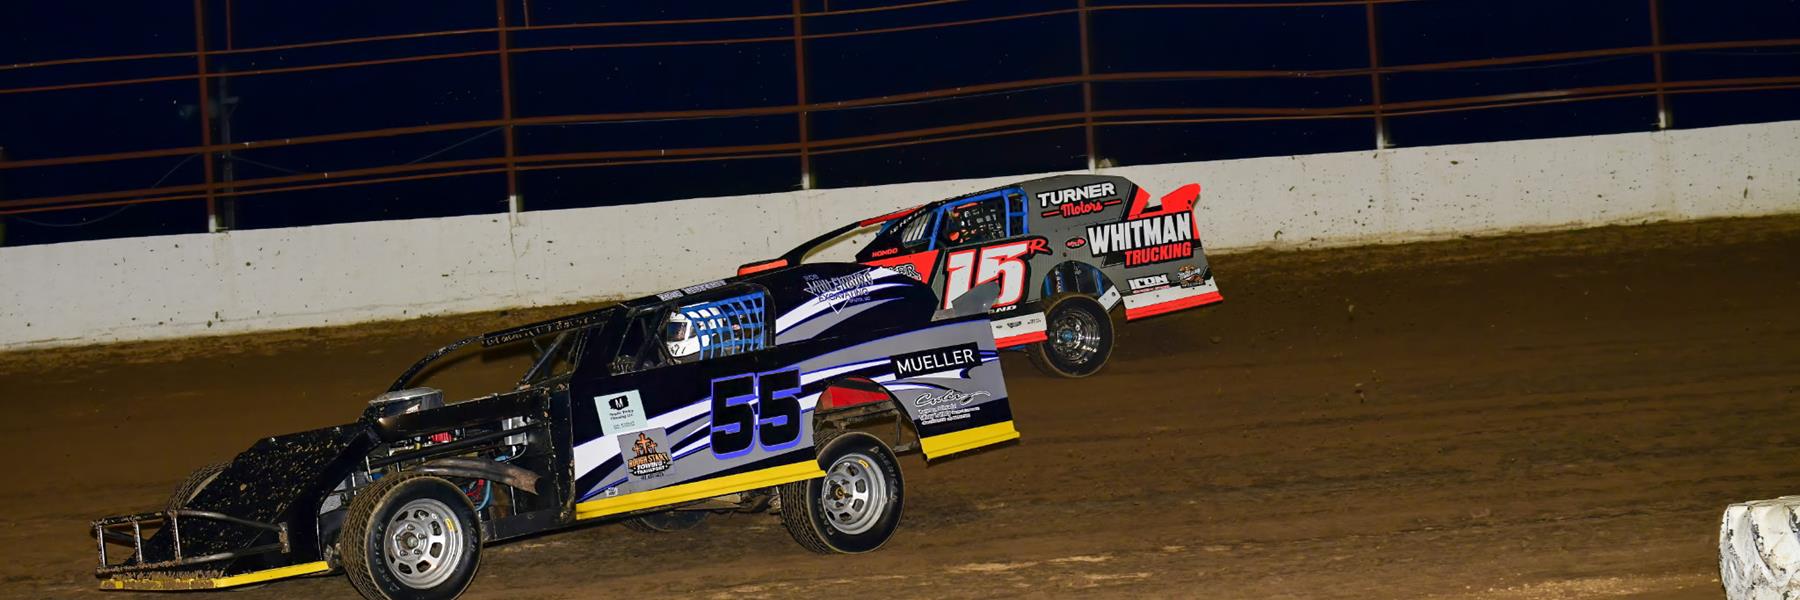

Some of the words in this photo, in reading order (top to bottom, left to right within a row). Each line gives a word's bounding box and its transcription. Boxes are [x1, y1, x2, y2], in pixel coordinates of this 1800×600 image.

[1037, 182, 1116, 207] TURNER
[1061, 201, 1104, 217] Motors
[1087, 212, 1192, 255] WHITMAN
[1125, 241, 1192, 266] TRUCKING
[1128, 274, 1171, 291] ICON
[896, 349, 976, 374] MUELLER
[710, 367, 802, 460] 55
